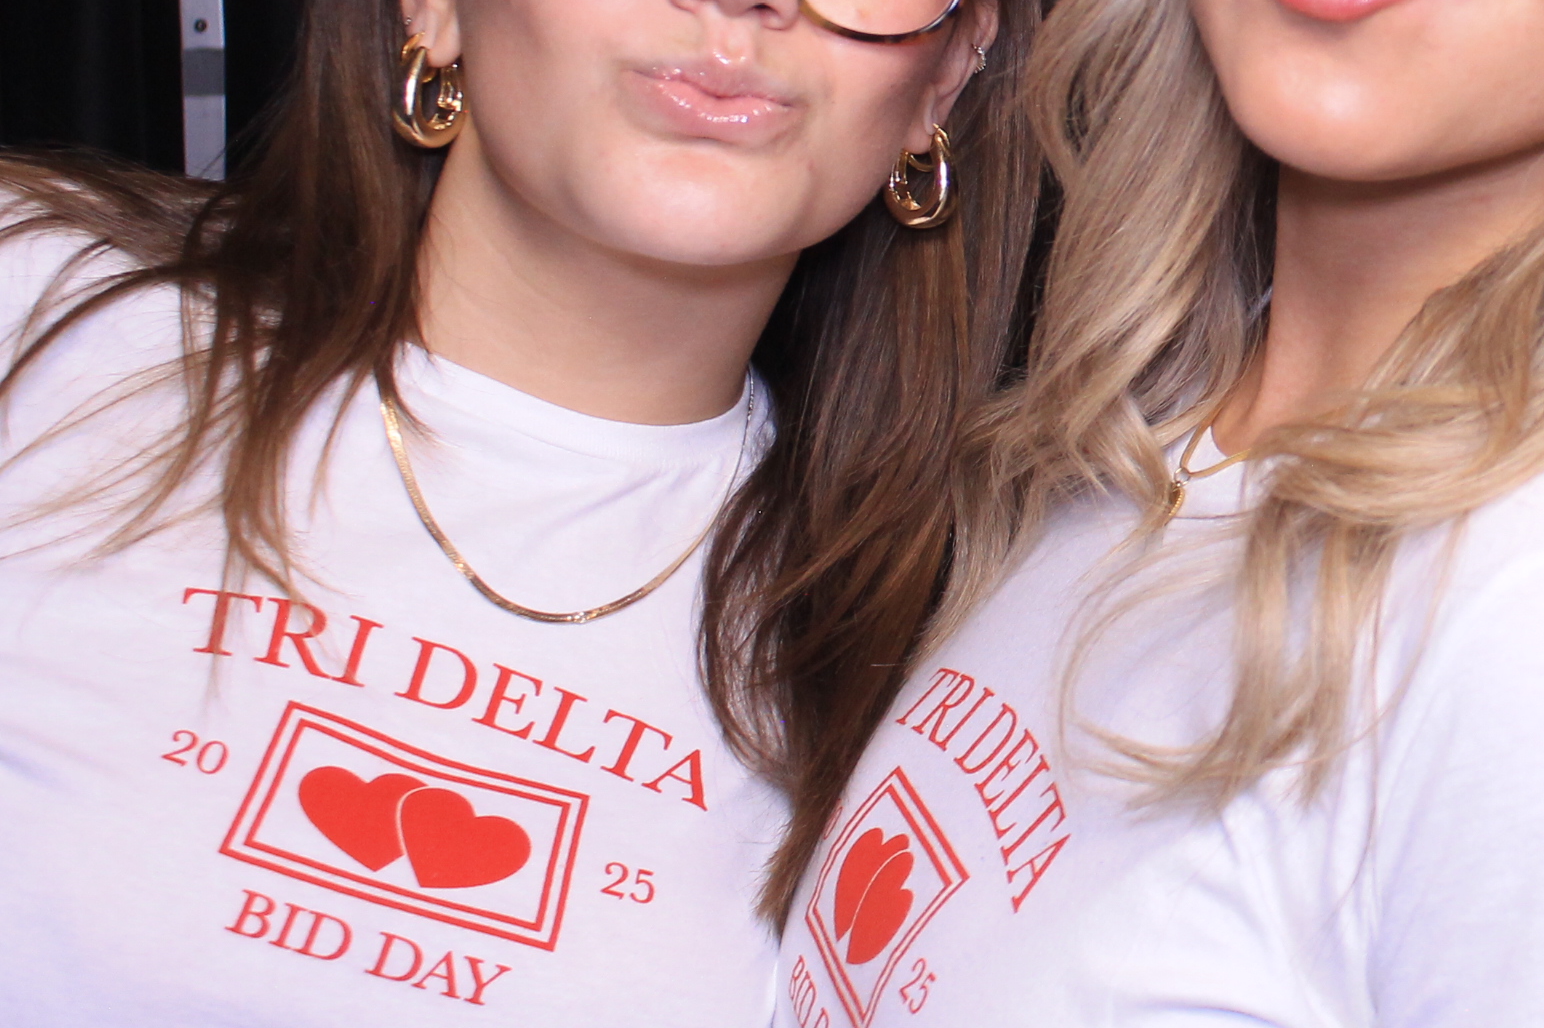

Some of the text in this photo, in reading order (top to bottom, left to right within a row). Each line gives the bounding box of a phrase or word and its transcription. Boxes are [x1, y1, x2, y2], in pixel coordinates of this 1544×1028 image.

[183, 587, 709, 812] TRI DELTA
[161, 729, 230, 775] 20
[895, 667, 1072, 914] TRI DELTA
[600, 861, 656, 904] 25
[225, 889, 513, 1006] BID DAY
[788, 954, 817, 1028] BID
[898, 957, 937, 1015] 25
